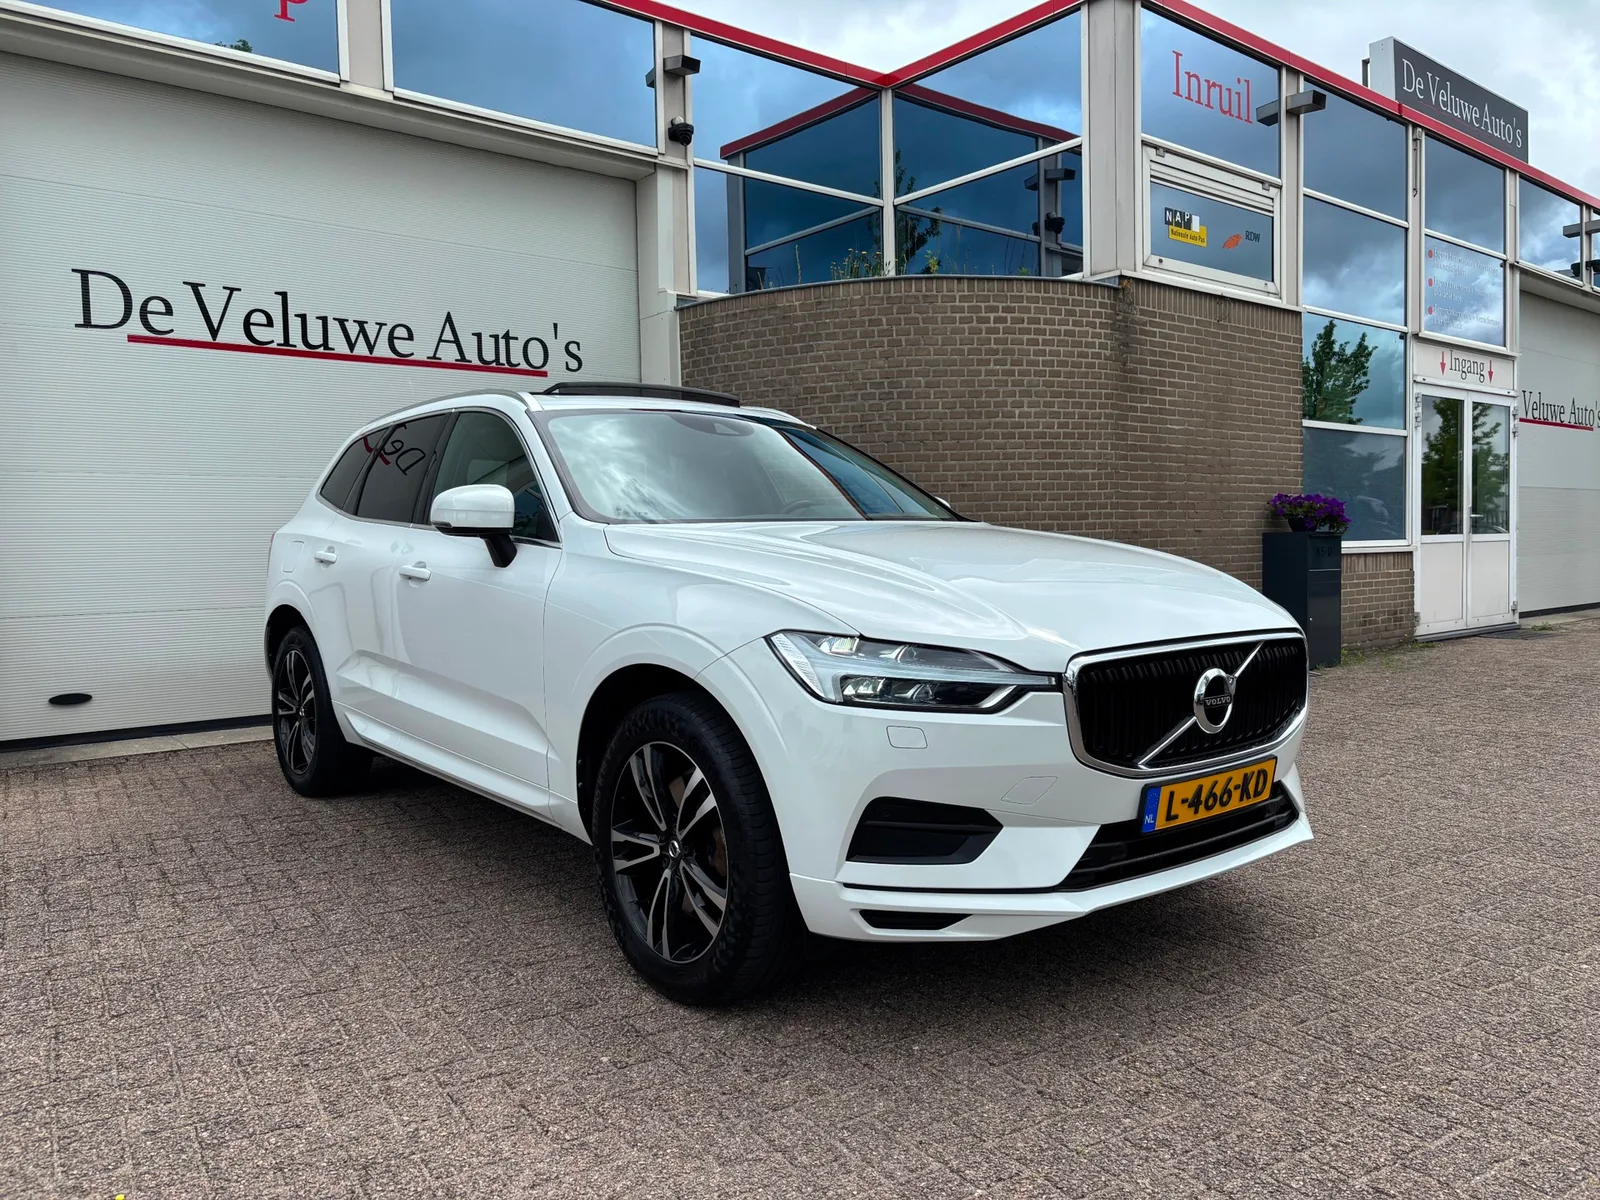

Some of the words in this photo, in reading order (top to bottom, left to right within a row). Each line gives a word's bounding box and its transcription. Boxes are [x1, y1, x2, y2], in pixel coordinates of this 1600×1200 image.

[1172, 50, 1253, 124] Inruil
[1402, 58, 1424, 99] De
[1426, 71, 1480, 127] Veluwe
[1481, 102, 1522, 148] Auto's
[1245, 230, 1261, 243] RDW
[71, 268, 174, 336] De
[183, 280, 416, 359] Veluwe
[426, 311, 584, 372] Auto's
[1449, 350, 1485, 383] Ingang
[1521, 390, 1566, 424] Veluwe
[1205, 696, 1231, 706] VOLVO
[1165, 767, 1269, 822] L-466-KD
[1144, 814, 1155, 825] NL
